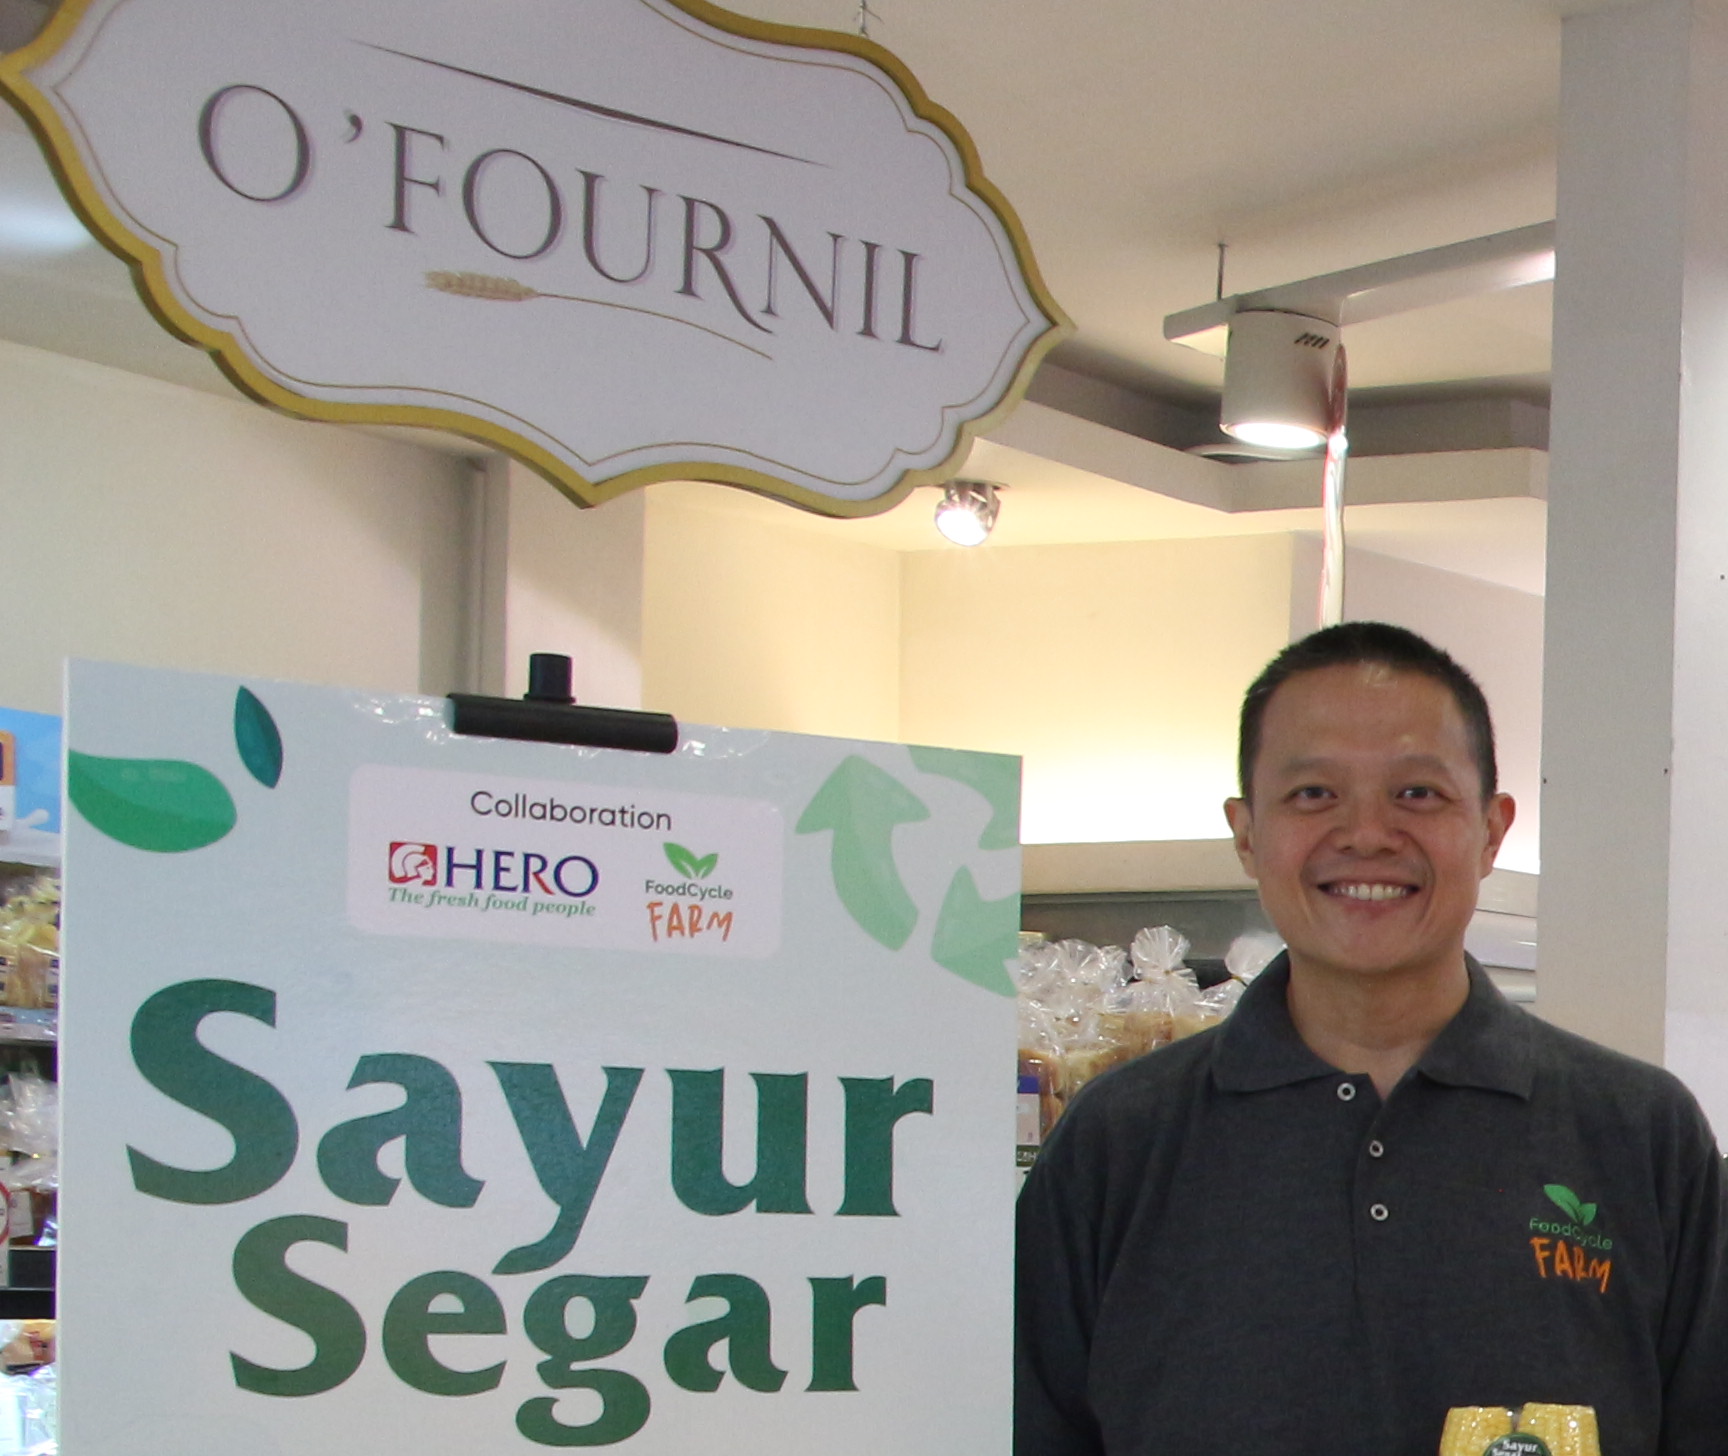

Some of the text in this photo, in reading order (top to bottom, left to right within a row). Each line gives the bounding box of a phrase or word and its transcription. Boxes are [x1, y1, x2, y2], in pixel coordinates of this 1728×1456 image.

[470, 790, 671, 831] Collaboration
[444, 846, 599, 898] HERO
[645, 880, 733, 900] FoodCycle
[388, 888, 597, 918] The fresh food people
[646, 901, 734, 942] FARM
[126, 977, 933, 1275] Sayur
[1529, 1236, 1612, 1294] FARM
[229, 1213, 887, 1447] Segar
